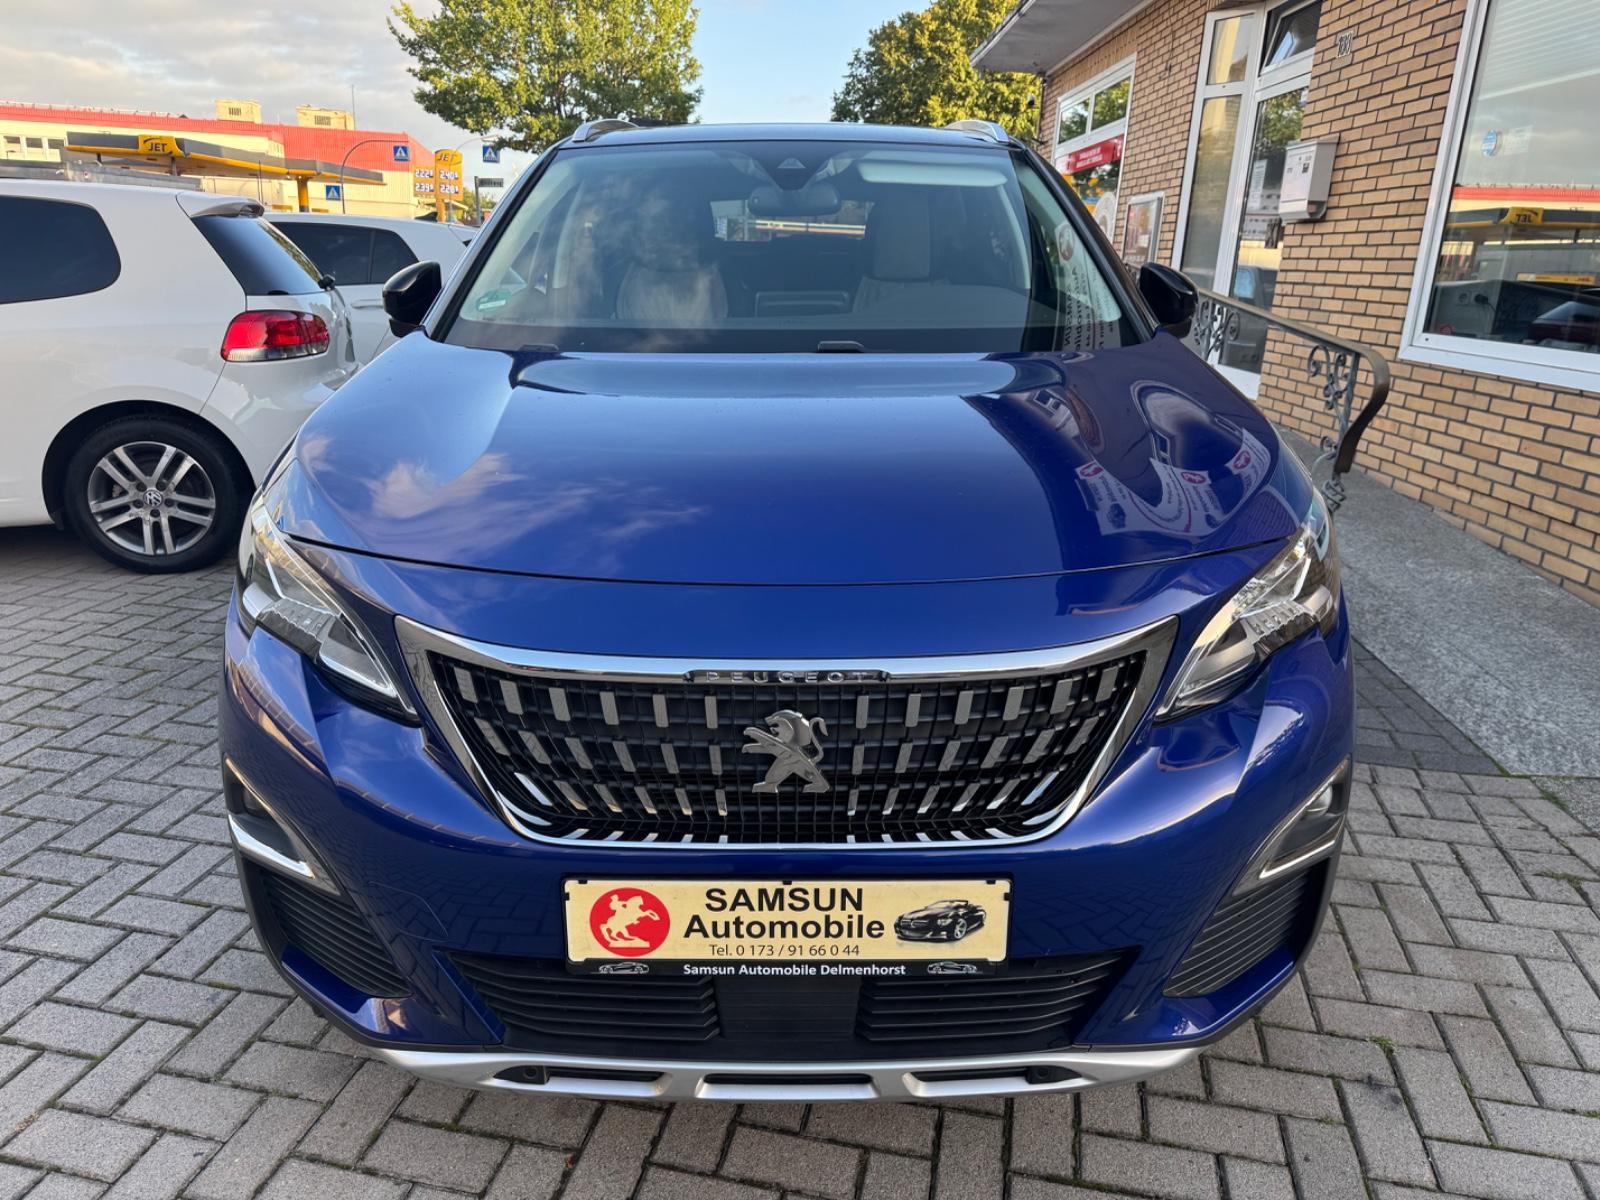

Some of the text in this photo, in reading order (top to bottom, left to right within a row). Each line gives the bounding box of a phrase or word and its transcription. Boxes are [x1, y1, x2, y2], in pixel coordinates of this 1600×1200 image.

[148, 142, 168, 152] JET
[437, 154, 458, 162] JET
[705, 671, 869, 683] PEUGEOT
[705, 887, 863, 912] SAMSUN
[683, 914, 885, 939] Automobile
[709, 944, 732, 956] Tel.
[736, 944, 745, 956] 0
[750, 944, 774, 956] 173
[788, 944, 803, 956] 91
[809, 944, 826, 956] 66
[831, 944, 839, 956] 0
[842, 944, 860, 956] 44
[683, 964, 906, 975] Samsun Automobile Delmenhorst
